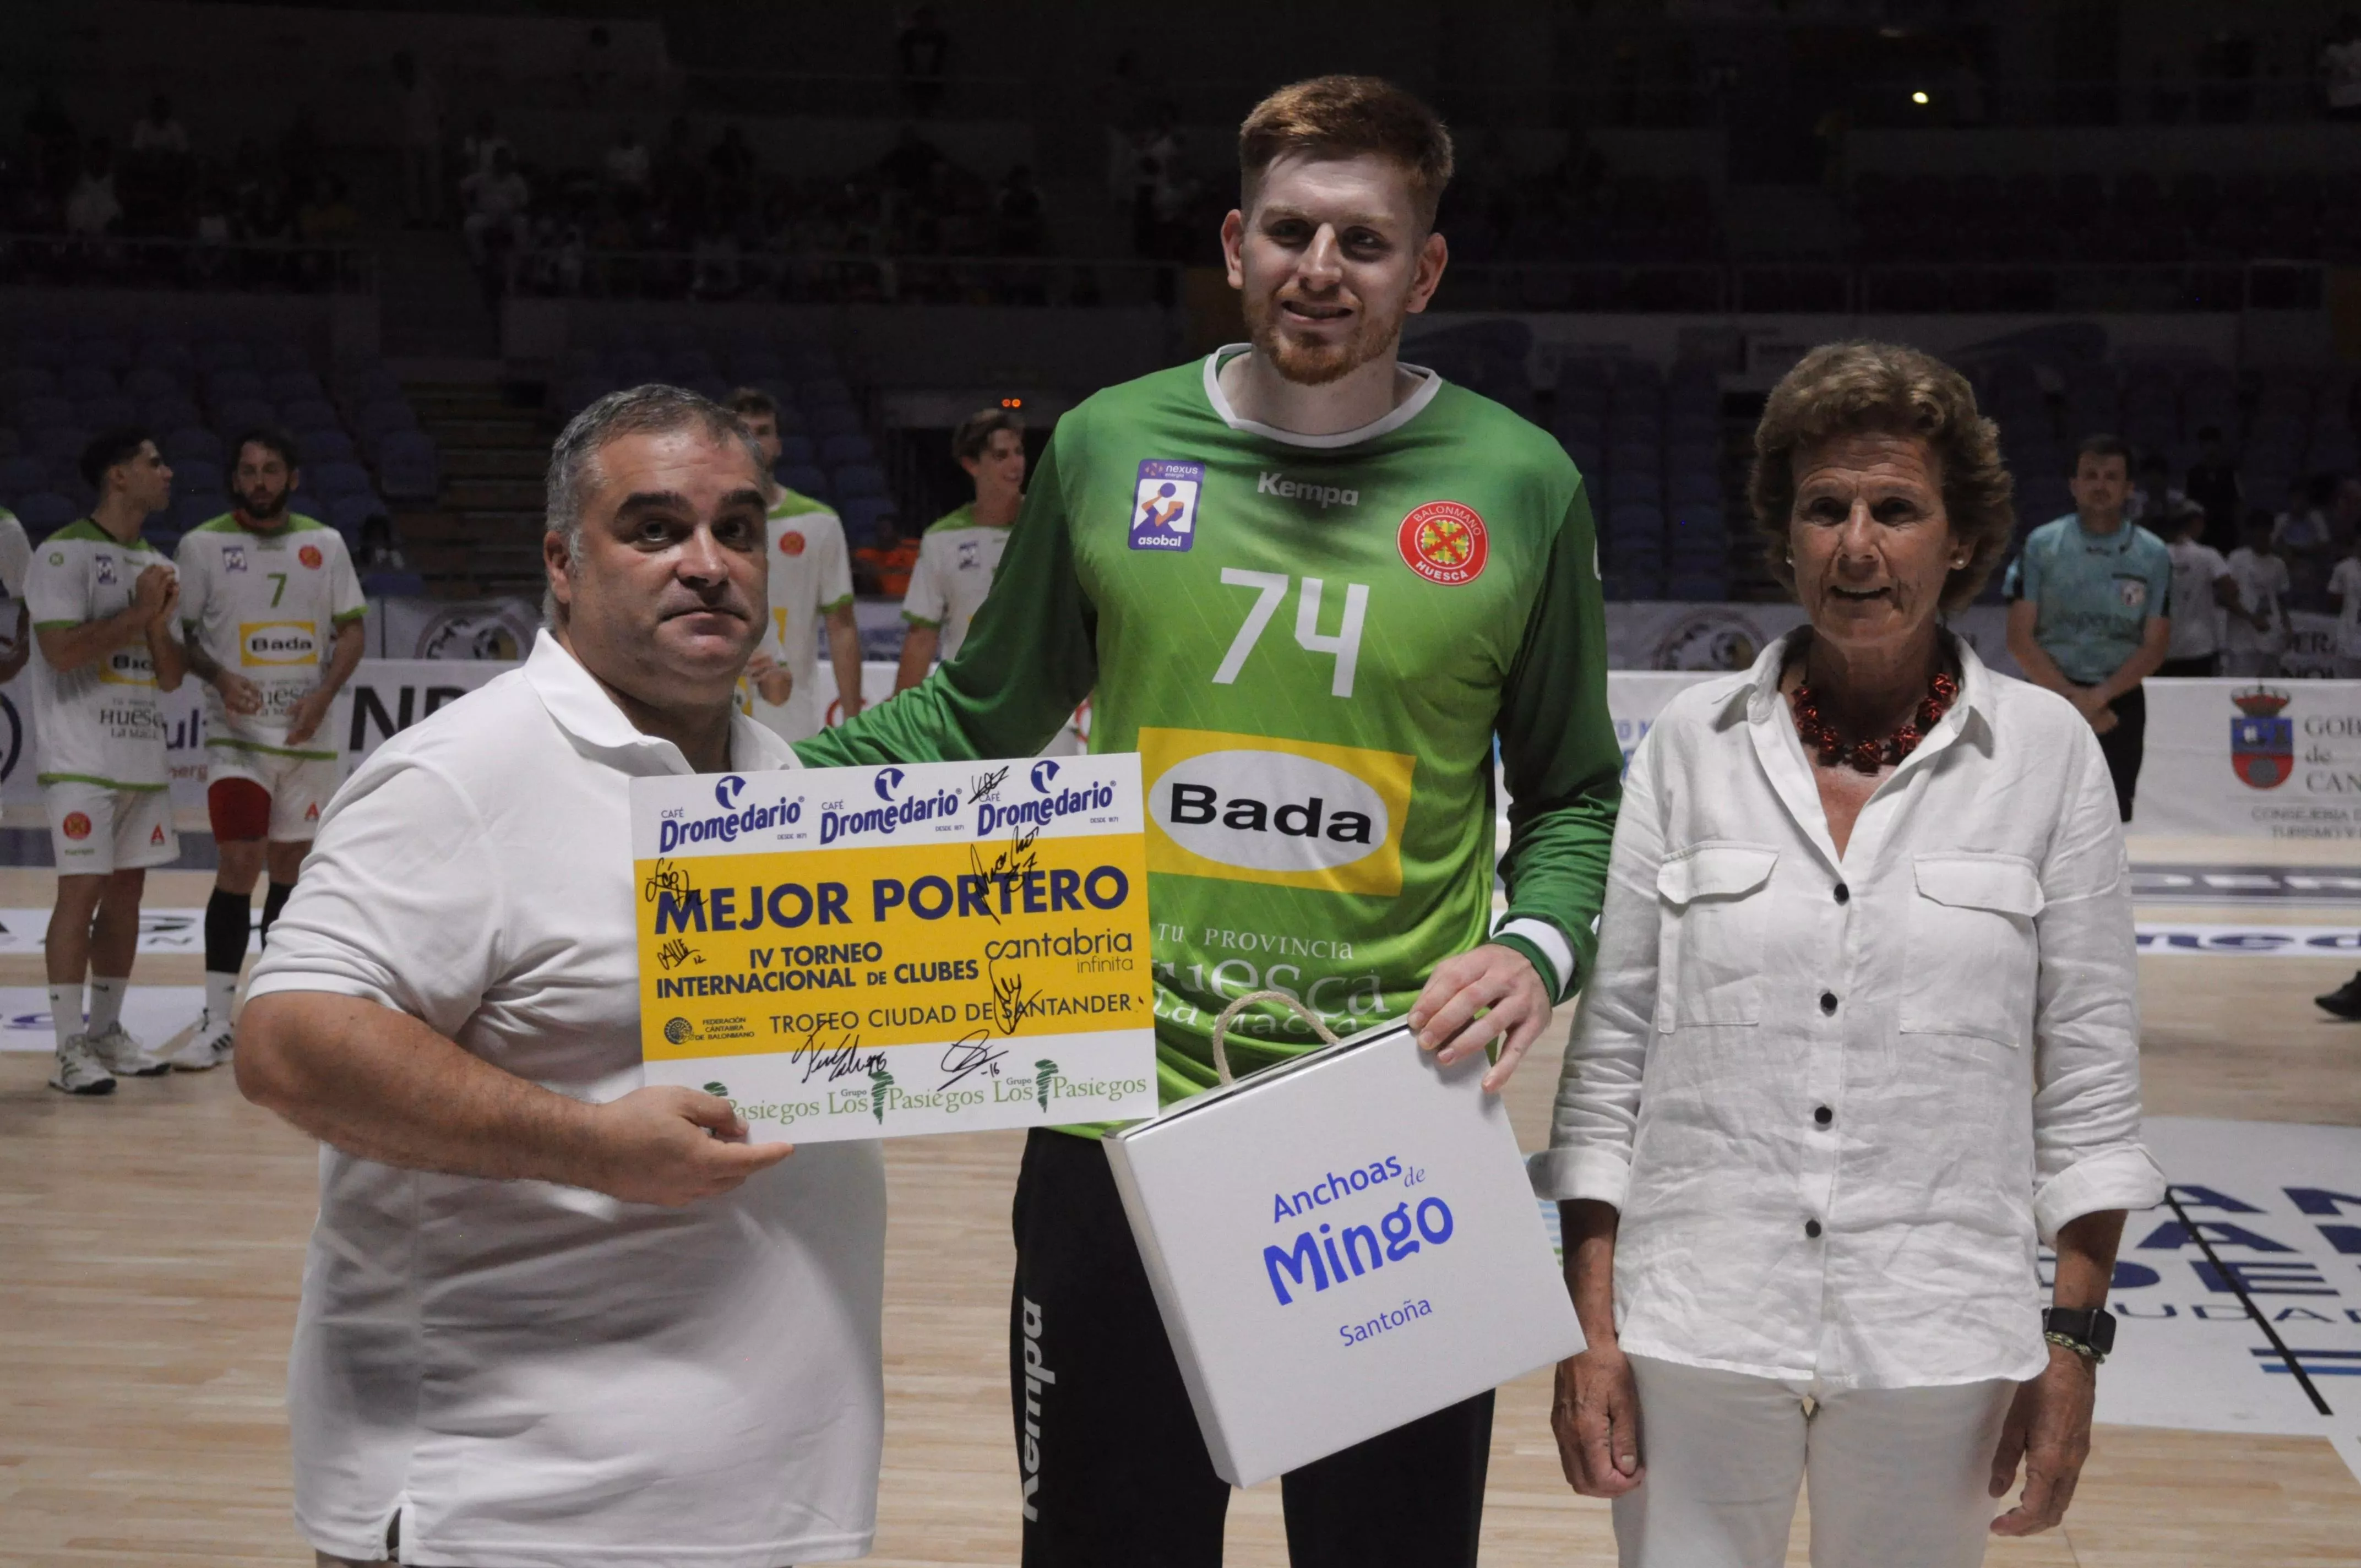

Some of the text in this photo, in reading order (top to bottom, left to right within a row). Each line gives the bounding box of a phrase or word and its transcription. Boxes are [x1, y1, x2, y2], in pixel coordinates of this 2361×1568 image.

[1166, 465, 1198, 475] nexus
[1258, 471, 1359, 509] Kempa
[1413, 505, 1482, 536] BALONMANO
[1138, 534, 1182, 547] asobal
[1416, 560, 1469, 581] HUESCA
[267, 573, 287, 609] 7
[1212, 560, 1370, 698] 74
[252, 638, 312, 652] Bada
[822, 801, 844, 810] CAFÉ
[979, 791, 1001, 803] CAFÉ
[661, 807, 684, 818] CAFÉ
[1171, 782, 1372, 845] Bada
[655, 881, 853, 935] MEJOR
[873, 865, 1129, 922] PORTERO
[749, 941, 883, 969] IV TORNEO
[984, 928, 1133, 961] cantabria
[1077, 955, 1134, 973] infinita
[657, 959, 979, 999] INTERNACIONAL DE CLUBES
[1151, 959, 1391, 1020] uesca
[703, 1016, 746, 1025] FEDERACIÓN
[769, 993, 1131, 1033] TROFEO CIUDAD DE SANTANDER
[708, 1031, 755, 1040] BALONMANO
[841, 1088, 867, 1098] Grupo
[993, 1076, 1147, 1103] Los Pasiegos
[1006, 1076, 1032, 1086] Grupo
[828, 1088, 984, 1115] Los Pasiegos
[1274, 1156, 1426, 1223] Anchoas de
[1263, 1196, 1454, 1306] Mingo
[1339, 1299, 1433, 1347] Santoña
